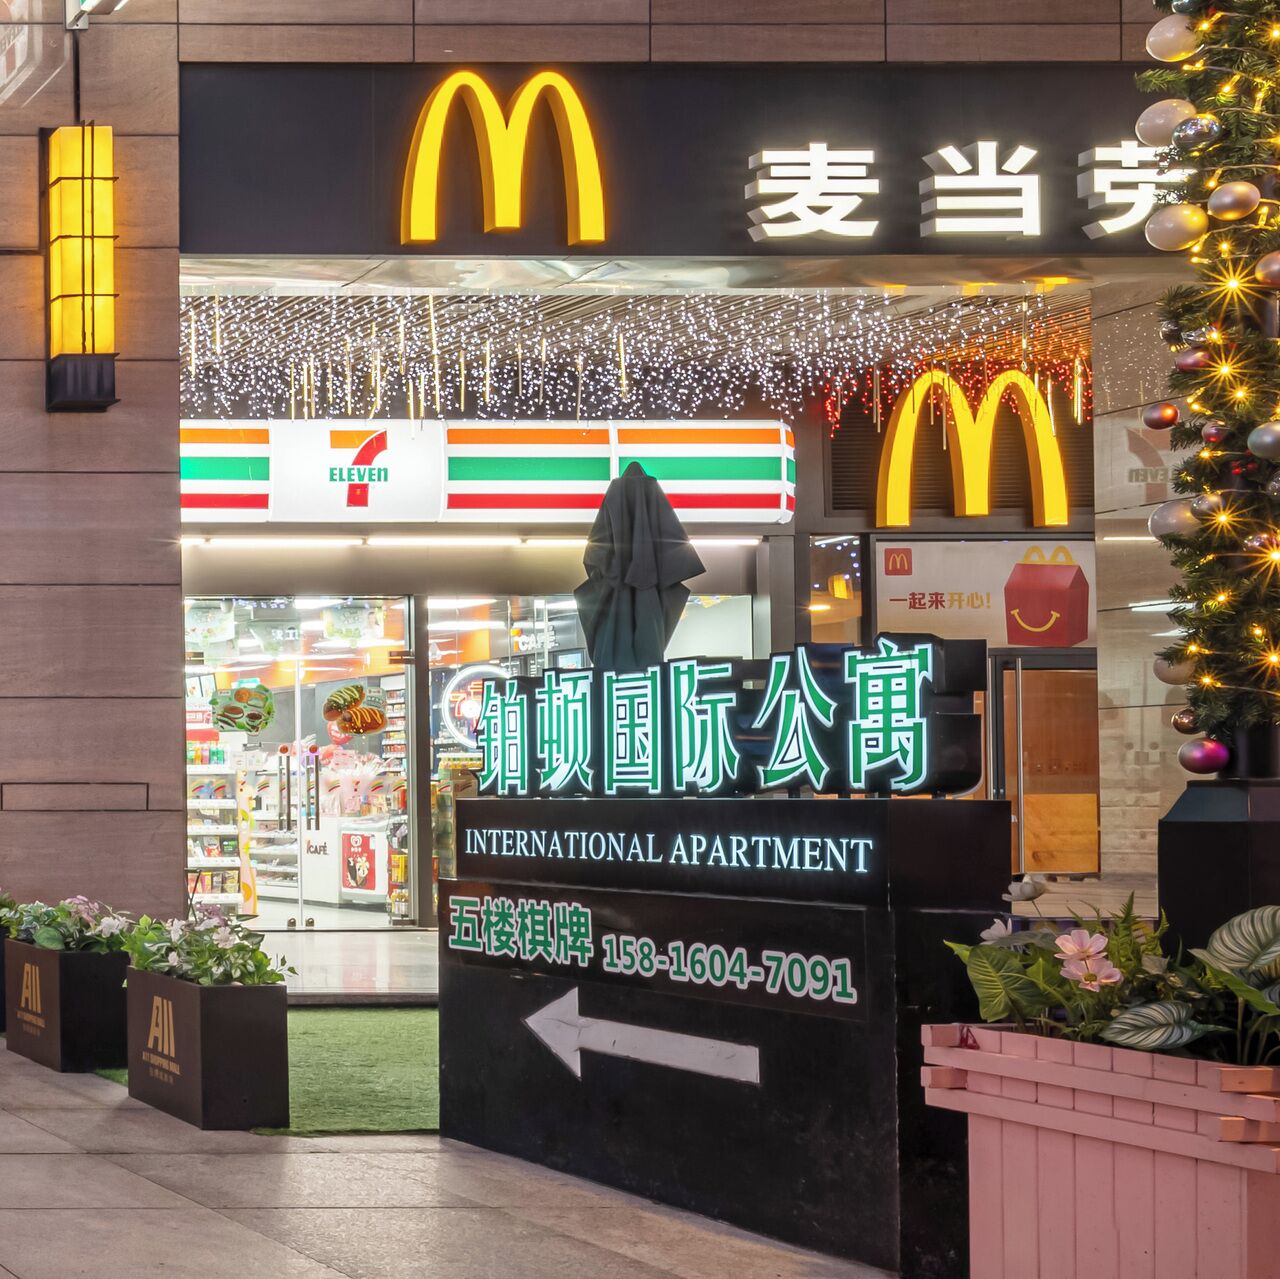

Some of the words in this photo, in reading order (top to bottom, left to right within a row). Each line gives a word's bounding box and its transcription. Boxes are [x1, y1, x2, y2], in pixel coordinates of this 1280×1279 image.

[889, 591, 991, 610] 一起来开心!
[477, 638, 933, 795] 铂顿国际公寓
[464, 828, 663, 865] INTERNATIONAL
[669, 833, 874, 874] APARTMENT
[448, 896, 594, 967] 五楼棋牌
[602, 933, 858, 1005] 158-1604-7091
